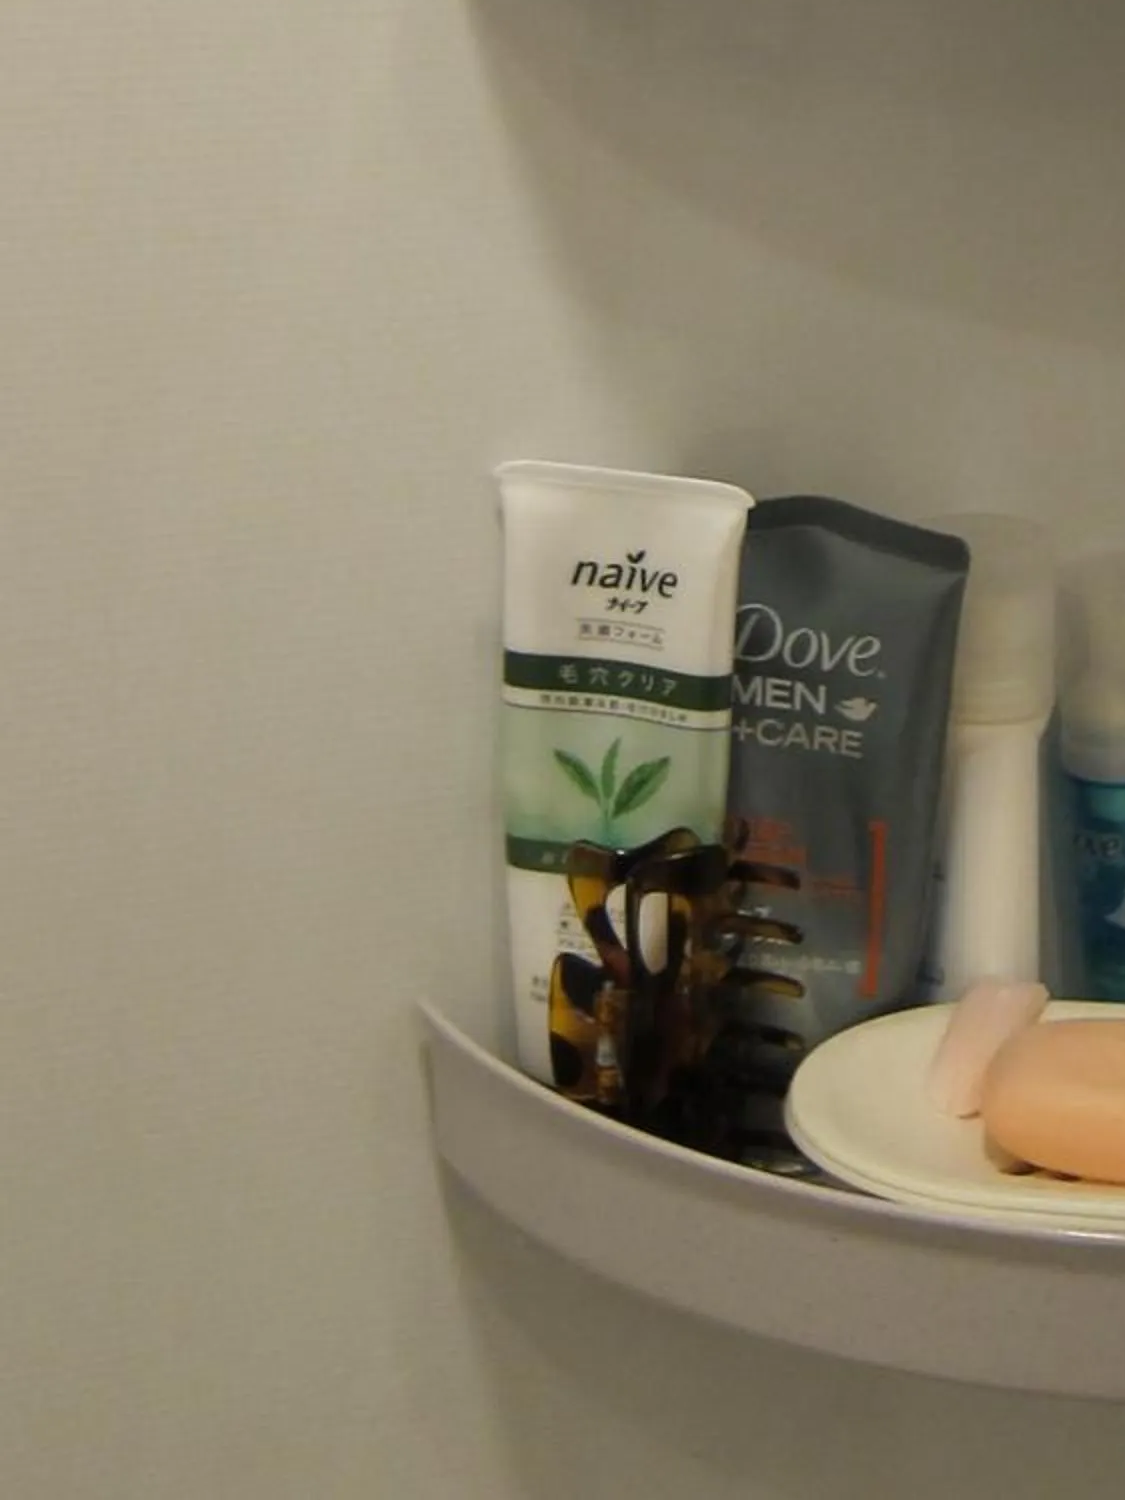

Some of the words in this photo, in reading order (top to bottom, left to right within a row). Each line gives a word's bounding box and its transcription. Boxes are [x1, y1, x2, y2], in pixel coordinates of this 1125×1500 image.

[735, 603, 881, 677] Dove
[558, 663, 679, 697] 毛穴クリア
[730, 674, 828, 715] MEN
[731, 717, 864, 759] +CARE
